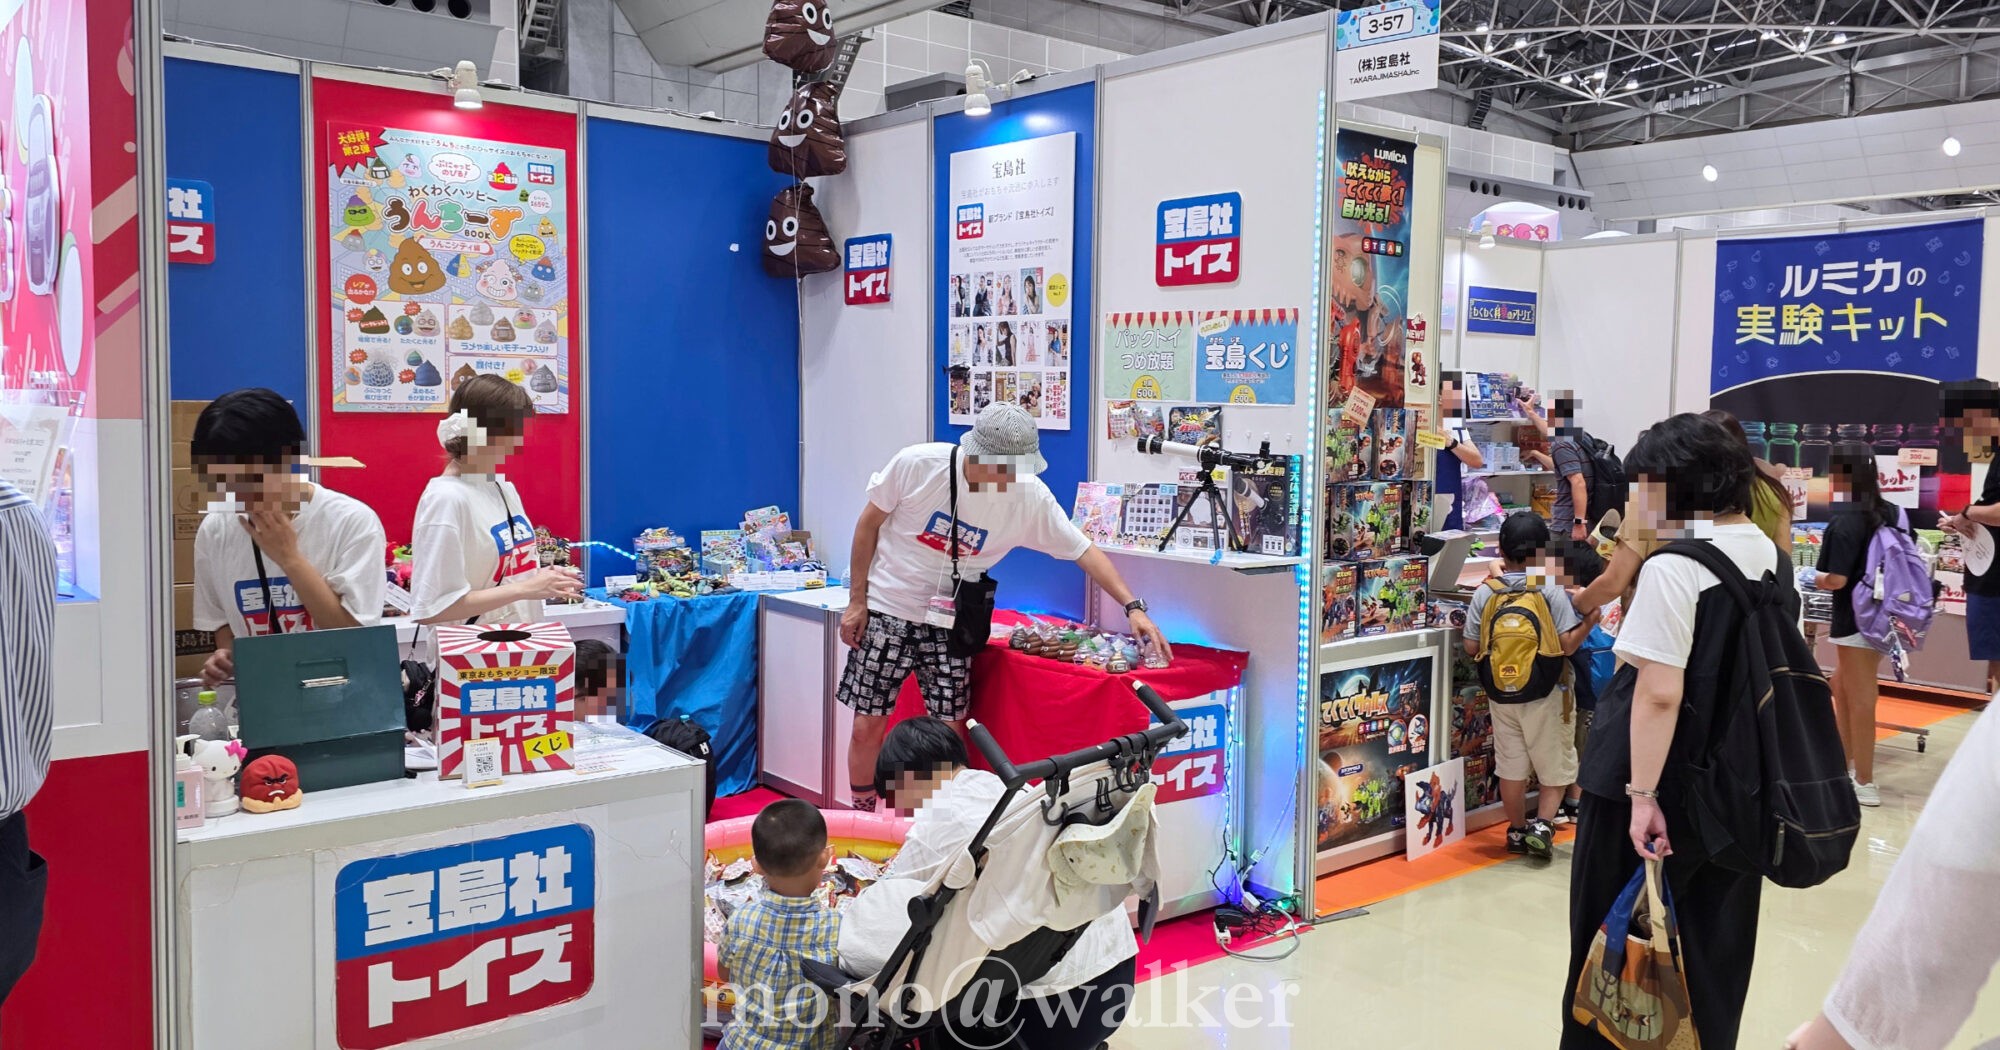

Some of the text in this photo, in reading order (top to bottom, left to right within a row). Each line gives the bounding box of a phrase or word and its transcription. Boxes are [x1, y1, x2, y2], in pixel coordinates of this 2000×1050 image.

[1368, 14, 1404, 34] 3-57
[1358, 52, 1411, 73] (株)宝島社
[343, 145, 371, 156] 第2弾
[993, 158, 1026, 179] 宝島社
[1347, 162, 1391, 183] 吠えながら
[408, 185, 498, 202] わくわくハッピー
[1345, 179, 1405, 206] てくてく歩く!
[1163, 202, 1233, 240] 宝島社
[1342, 198, 1390, 223] 目が光る!
[464, 229, 491, 240] BOOK
[849, 241, 888, 269] 宝島社
[1163, 242, 1232, 277] トイズ
[1780, 258, 1927, 298] ルミカの
[1735, 297, 1948, 345] 実験キット
[460, 342, 549, 353] ラメや楽しいモチーフ入り!
[1115, 329, 1182, 349] パックトイ
[1121, 352, 1175, 370] つめ放題
[1205, 342, 1289, 370] 宝島くじ
[459, 667, 557, 680] 東京おもちゃショー限定
[469, 685, 547, 712] 宝島社
[471, 714, 547, 740] トイズ
[532, 737, 562, 755] くじ
[363, 845, 572, 946] 宝島社
[367, 923, 572, 1028] トイズ
